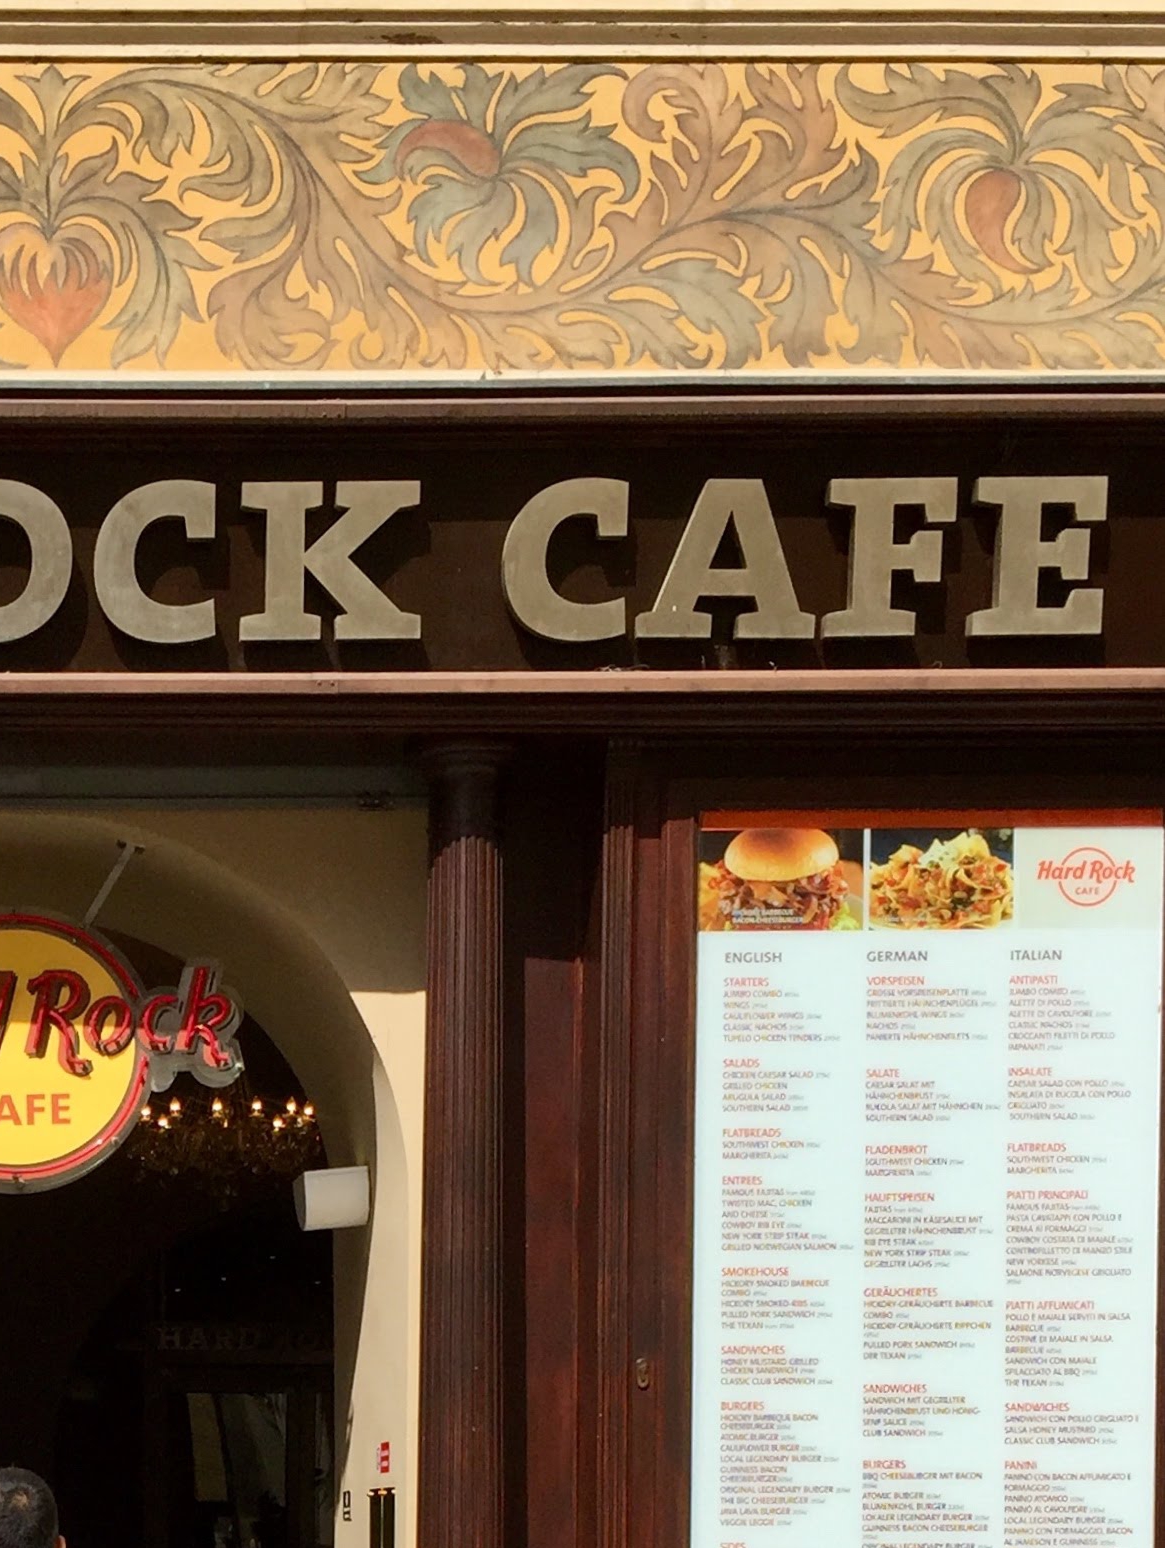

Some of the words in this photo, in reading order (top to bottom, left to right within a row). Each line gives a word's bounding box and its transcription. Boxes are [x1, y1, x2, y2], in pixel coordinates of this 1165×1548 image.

[501, 474, 1110, 644] CAFE
[1036, 861, 1087, 880] Hard
[1090, 862, 1135, 884] Rock
[1075, 887, 1100, 895] CAFE
[725, 952, 783, 963] ENGLISH
[866, 951, 928, 962] GERMAN
[1010, 950, 1062, 960] ITALIAN
[723, 978, 769, 987] STARTERS
[867, 976, 925, 985] VORSPEISEN
[1009, 976, 1058, 984] ANTIPASTI
[24, 965, 238, 1078] Rock
[723, 1059, 760, 1067] SALADS
[866, 1069, 900, 1078] SALATE
[1008, 1067, 1052, 1076] INSALATE
[722, 1128, 781, 1137] FLATBREADS
[865, 1145, 928, 1154] FLADENBROT
[1007, 1143, 1066, 1152] FLATBREADS
[722, 1176, 763, 1185] ENTREES
[721, 1267, 789, 1276] SMOKEHOUSE
[1006, 1301, 1034, 1309] PIATTI
[863, 1384, 927, 1393] SANDWICHES
[721, 1402, 764, 1411] BURGERS
[1005, 1403, 1069, 1412] SANDWICHES
[862, 1460, 906, 1469] BURGERS
